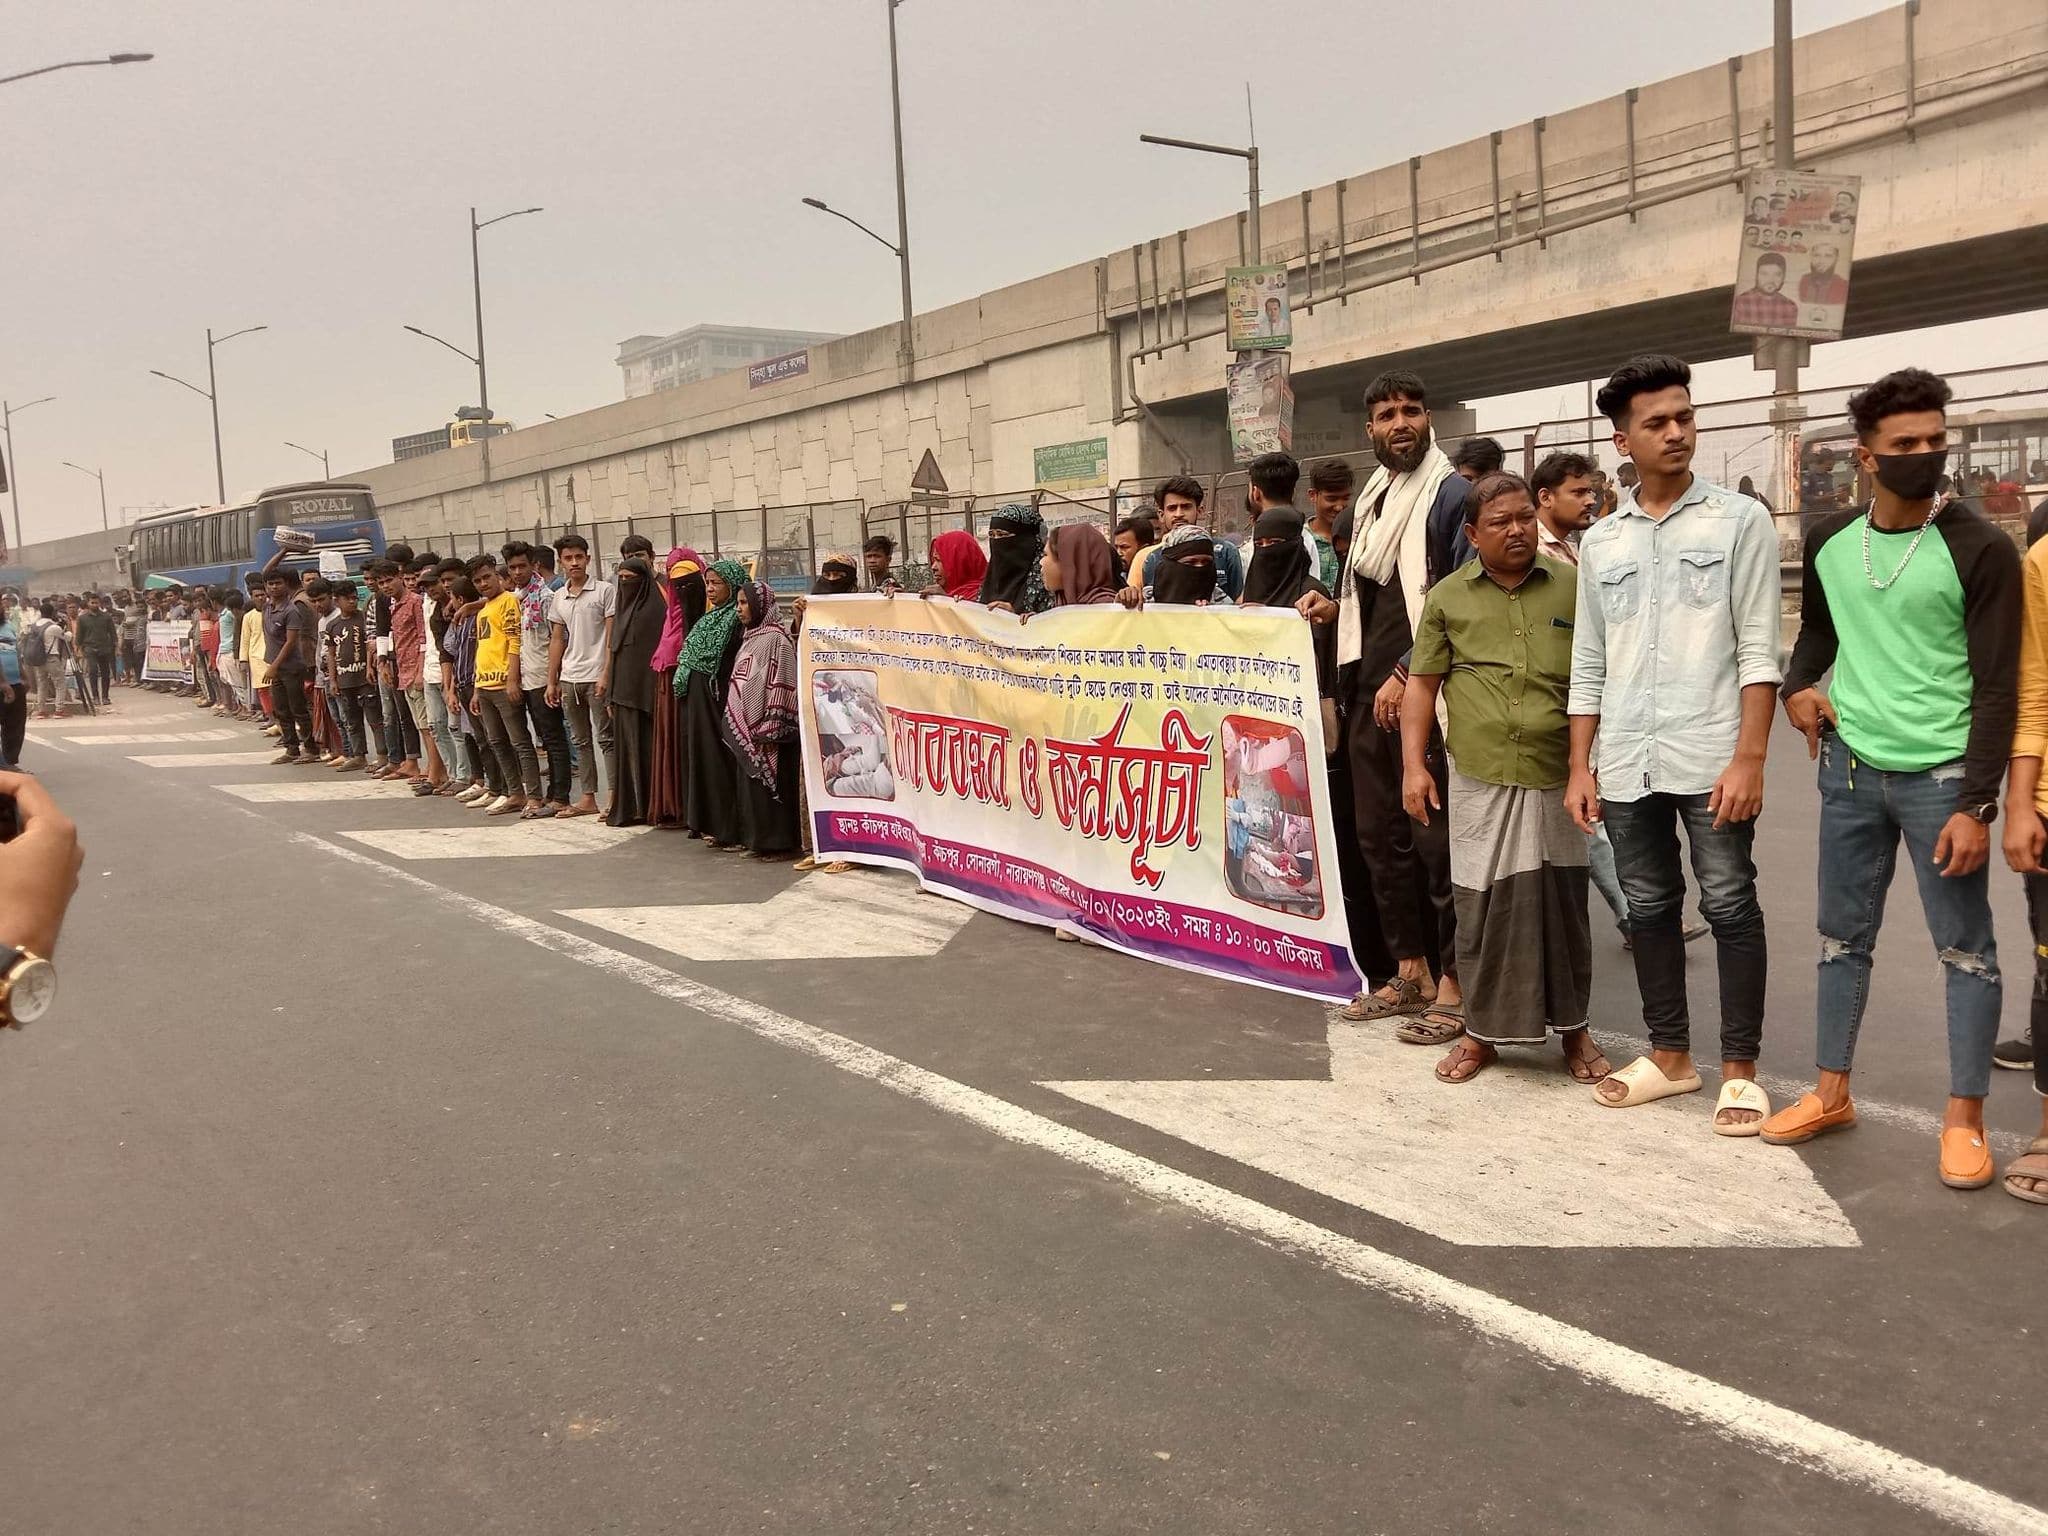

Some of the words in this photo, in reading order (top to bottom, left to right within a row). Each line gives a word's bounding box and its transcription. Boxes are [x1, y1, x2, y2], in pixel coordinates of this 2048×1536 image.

[289, 498, 354, 514] ROYAL
[1098, 650, 1124, 668] আমার
[1019, 738, 1044, 818] ও
[1181, 914, 1211, 941] সময়
